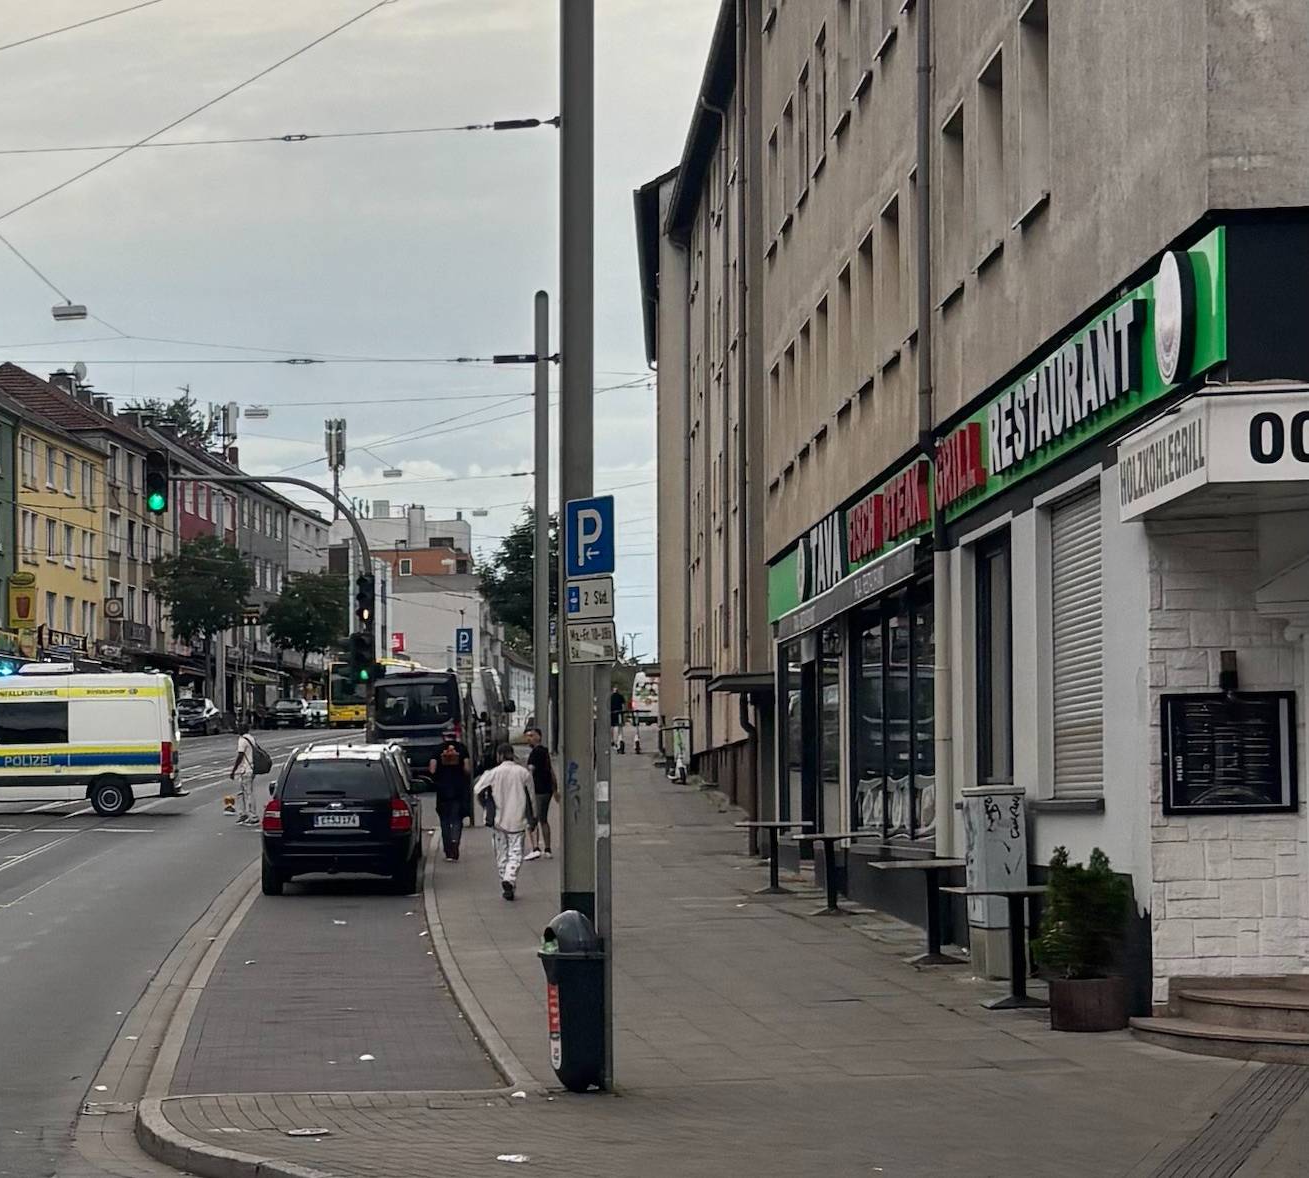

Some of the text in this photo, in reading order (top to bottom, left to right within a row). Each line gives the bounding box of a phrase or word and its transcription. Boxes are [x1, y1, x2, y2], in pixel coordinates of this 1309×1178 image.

[989, 299, 1134, 476] RESTAURANT
[1120, 418, 1205, 506] HOLZKOHLEGRILL
[577, 508, 603, 567] P
[810, 511, 842, 597] TAVA
[883, 461, 921, 541] STEAK
[935, 424, 978, 512] GRILL
[4, 756, 51, 767] POLIZEI
